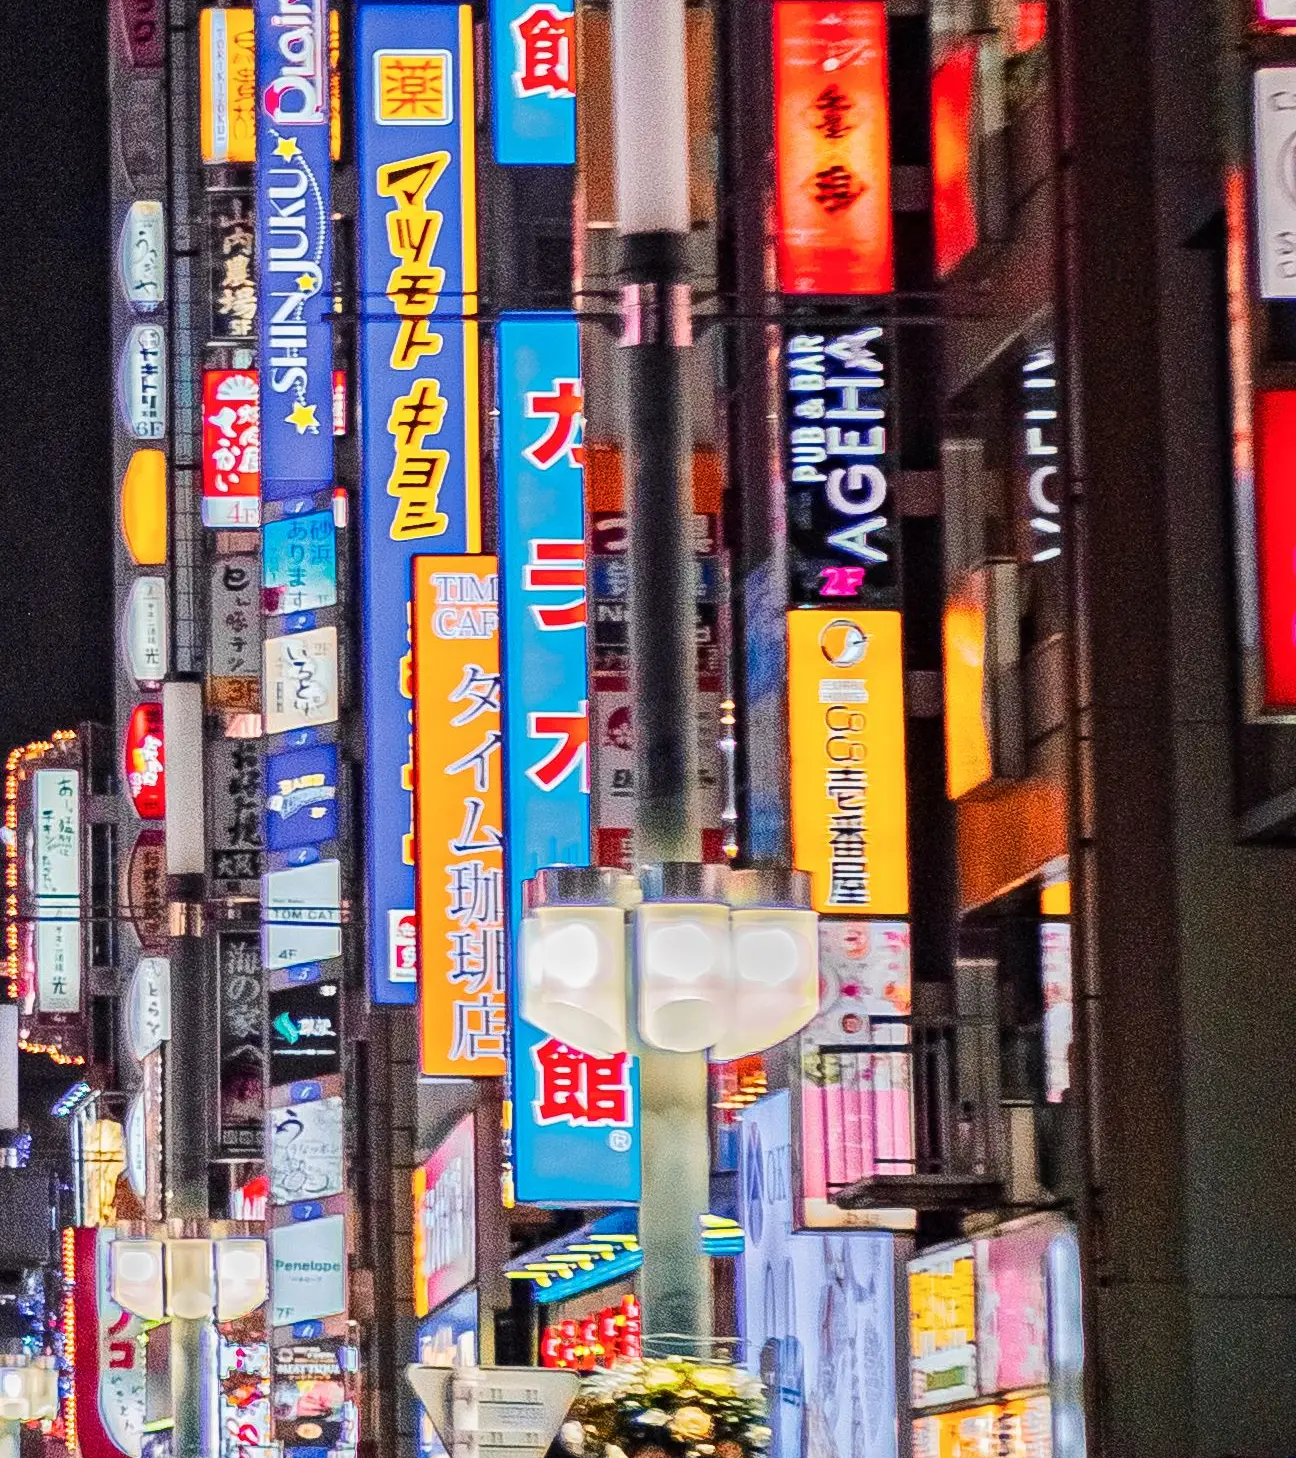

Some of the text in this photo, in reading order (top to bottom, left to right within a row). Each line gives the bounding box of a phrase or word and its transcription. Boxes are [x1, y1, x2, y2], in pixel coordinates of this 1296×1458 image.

[384, 59, 446, 116] 薬
[268, 168, 324, 394] SHINJUKU
[380, 152, 451, 541] マツモトキヨシ
[789, 334, 826, 392] BAR
[135, 421, 162, 437] 6F
[825, 326, 888, 563] AGEHA
[791, 426, 827, 483] PUB
[287, 521, 307, 606] あります
[819, 566, 866, 597] 2F
[430, 573, 498, 607] TIM
[432, 606, 498, 641] CAF
[444, 663, 506, 1061] タイム珈琲店
[307, 909, 334, 920] CAT
[278, 948, 298, 960] 4F
[275, 1259, 341, 1273] Penelope
[276, 1307, 294, 1320] 7F
